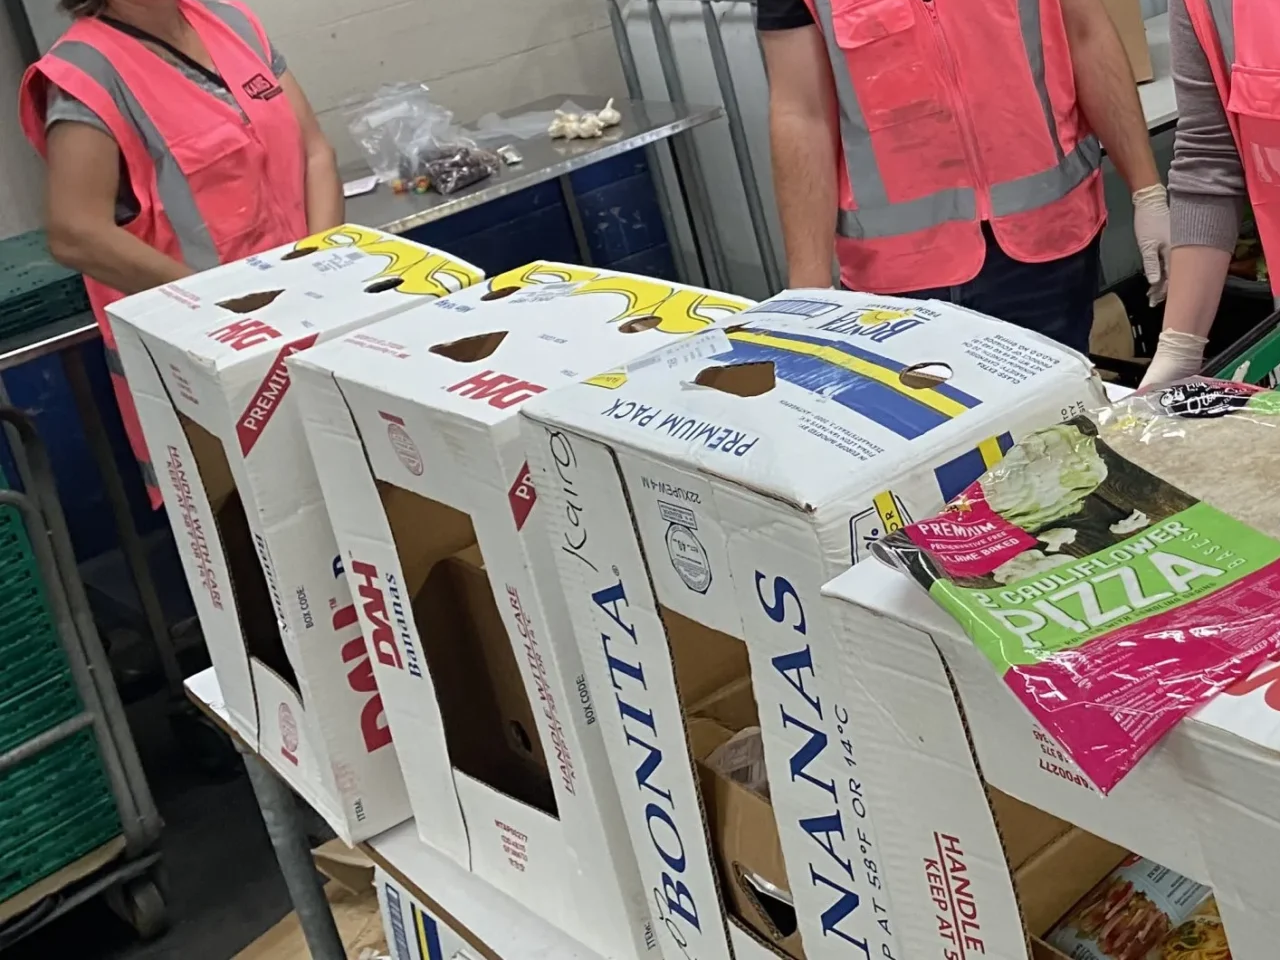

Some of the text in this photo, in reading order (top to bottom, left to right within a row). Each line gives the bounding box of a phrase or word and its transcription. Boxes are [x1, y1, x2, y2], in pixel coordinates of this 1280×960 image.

[601, 397, 760, 457] PREMIUM PACK
[918, 521, 997, 538] PREMIUM
[982, 538, 1020, 556] BAKED
[1180, 531, 1248, 570] BASES
[192, 518, 212, 563] WITH
[206, 568, 224, 610] CARE
[1001, 520, 1193, 606] CAULIFLOWER
[302, 609, 314, 629] BOX
[384, 572, 424, 677] Bananas
[506, 583, 528, 635] CARE
[986, 551, 1228, 650] PIZZA
[524, 645, 546, 700] WITH
[585, 706, 595, 726] BOX
[848, 777, 866, 818] OR
[872, 896, 893, 936] AT
[922, 857, 948, 912] KEEP
[935, 914, 957, 945] AT
[940, 833, 986, 955] HANDLE
